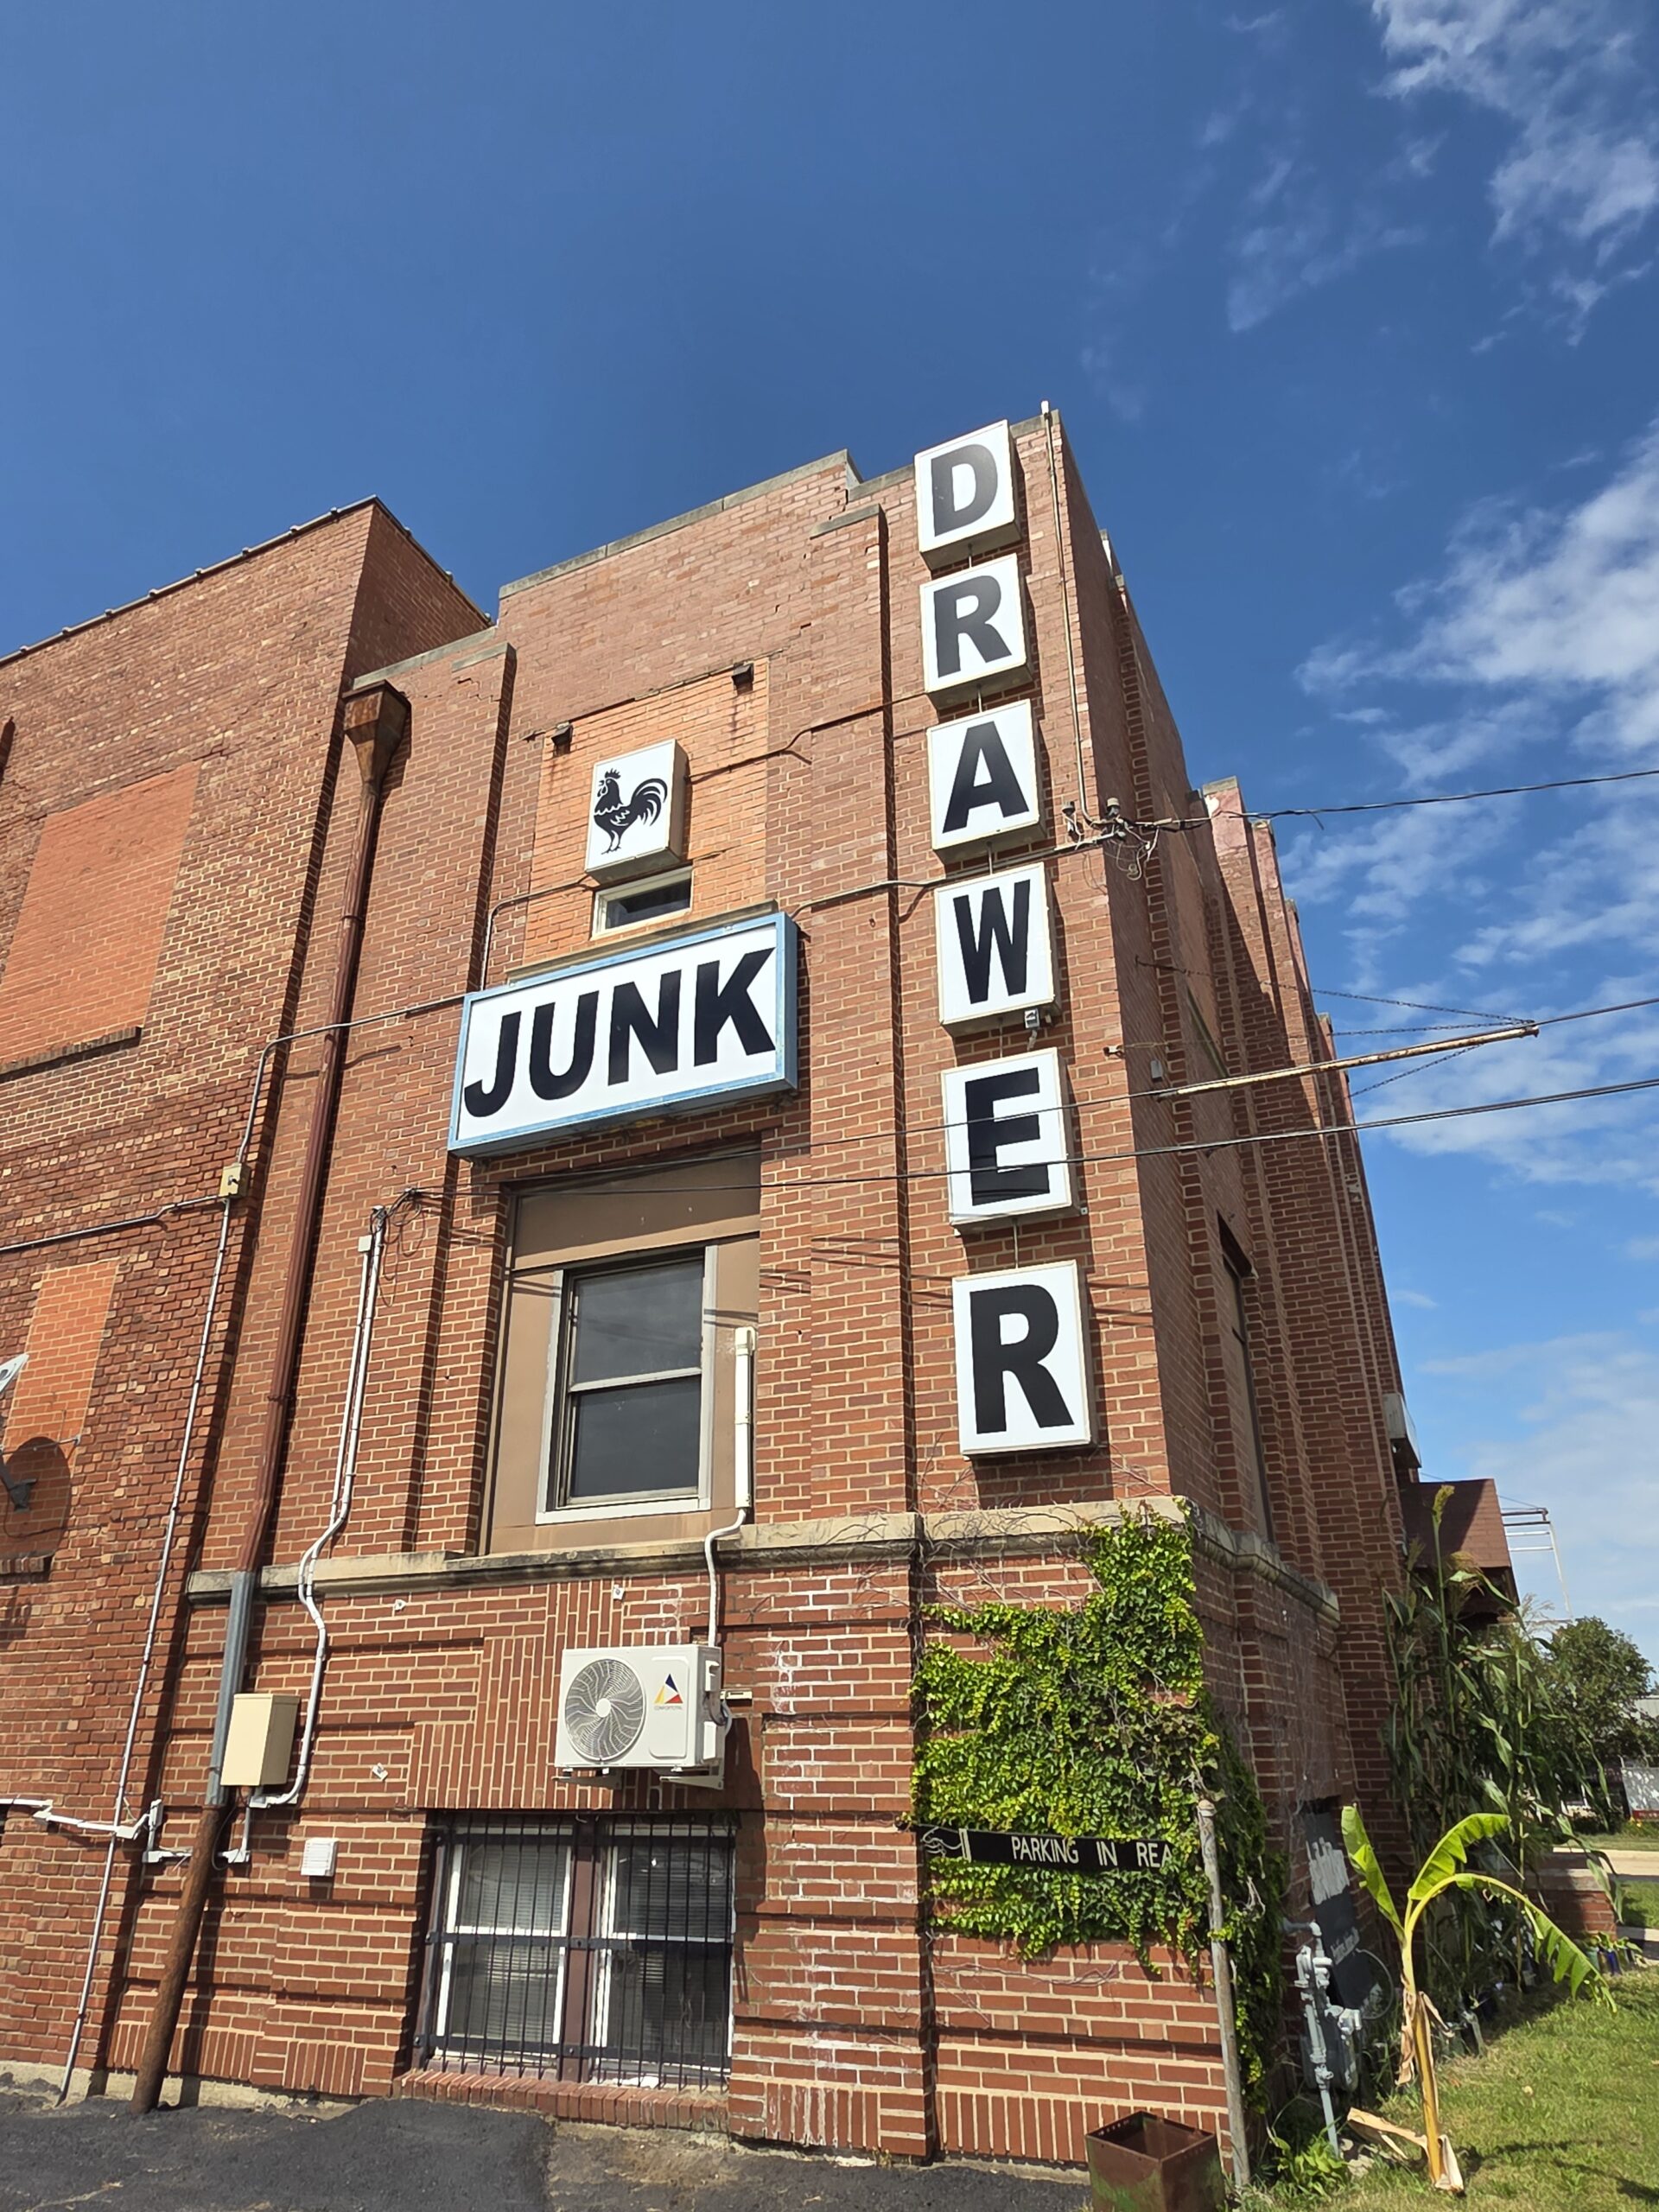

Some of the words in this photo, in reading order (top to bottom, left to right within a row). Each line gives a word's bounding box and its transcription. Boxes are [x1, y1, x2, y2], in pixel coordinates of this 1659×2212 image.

[931, 443, 1075, 1434] DRAWER
[464, 947, 777, 1118] JUNK
[1011, 1835, 1079, 1864] PARKING
[1096, 1840, 1118, 1866] IN
[1135, 1841, 1173, 1868] REA
